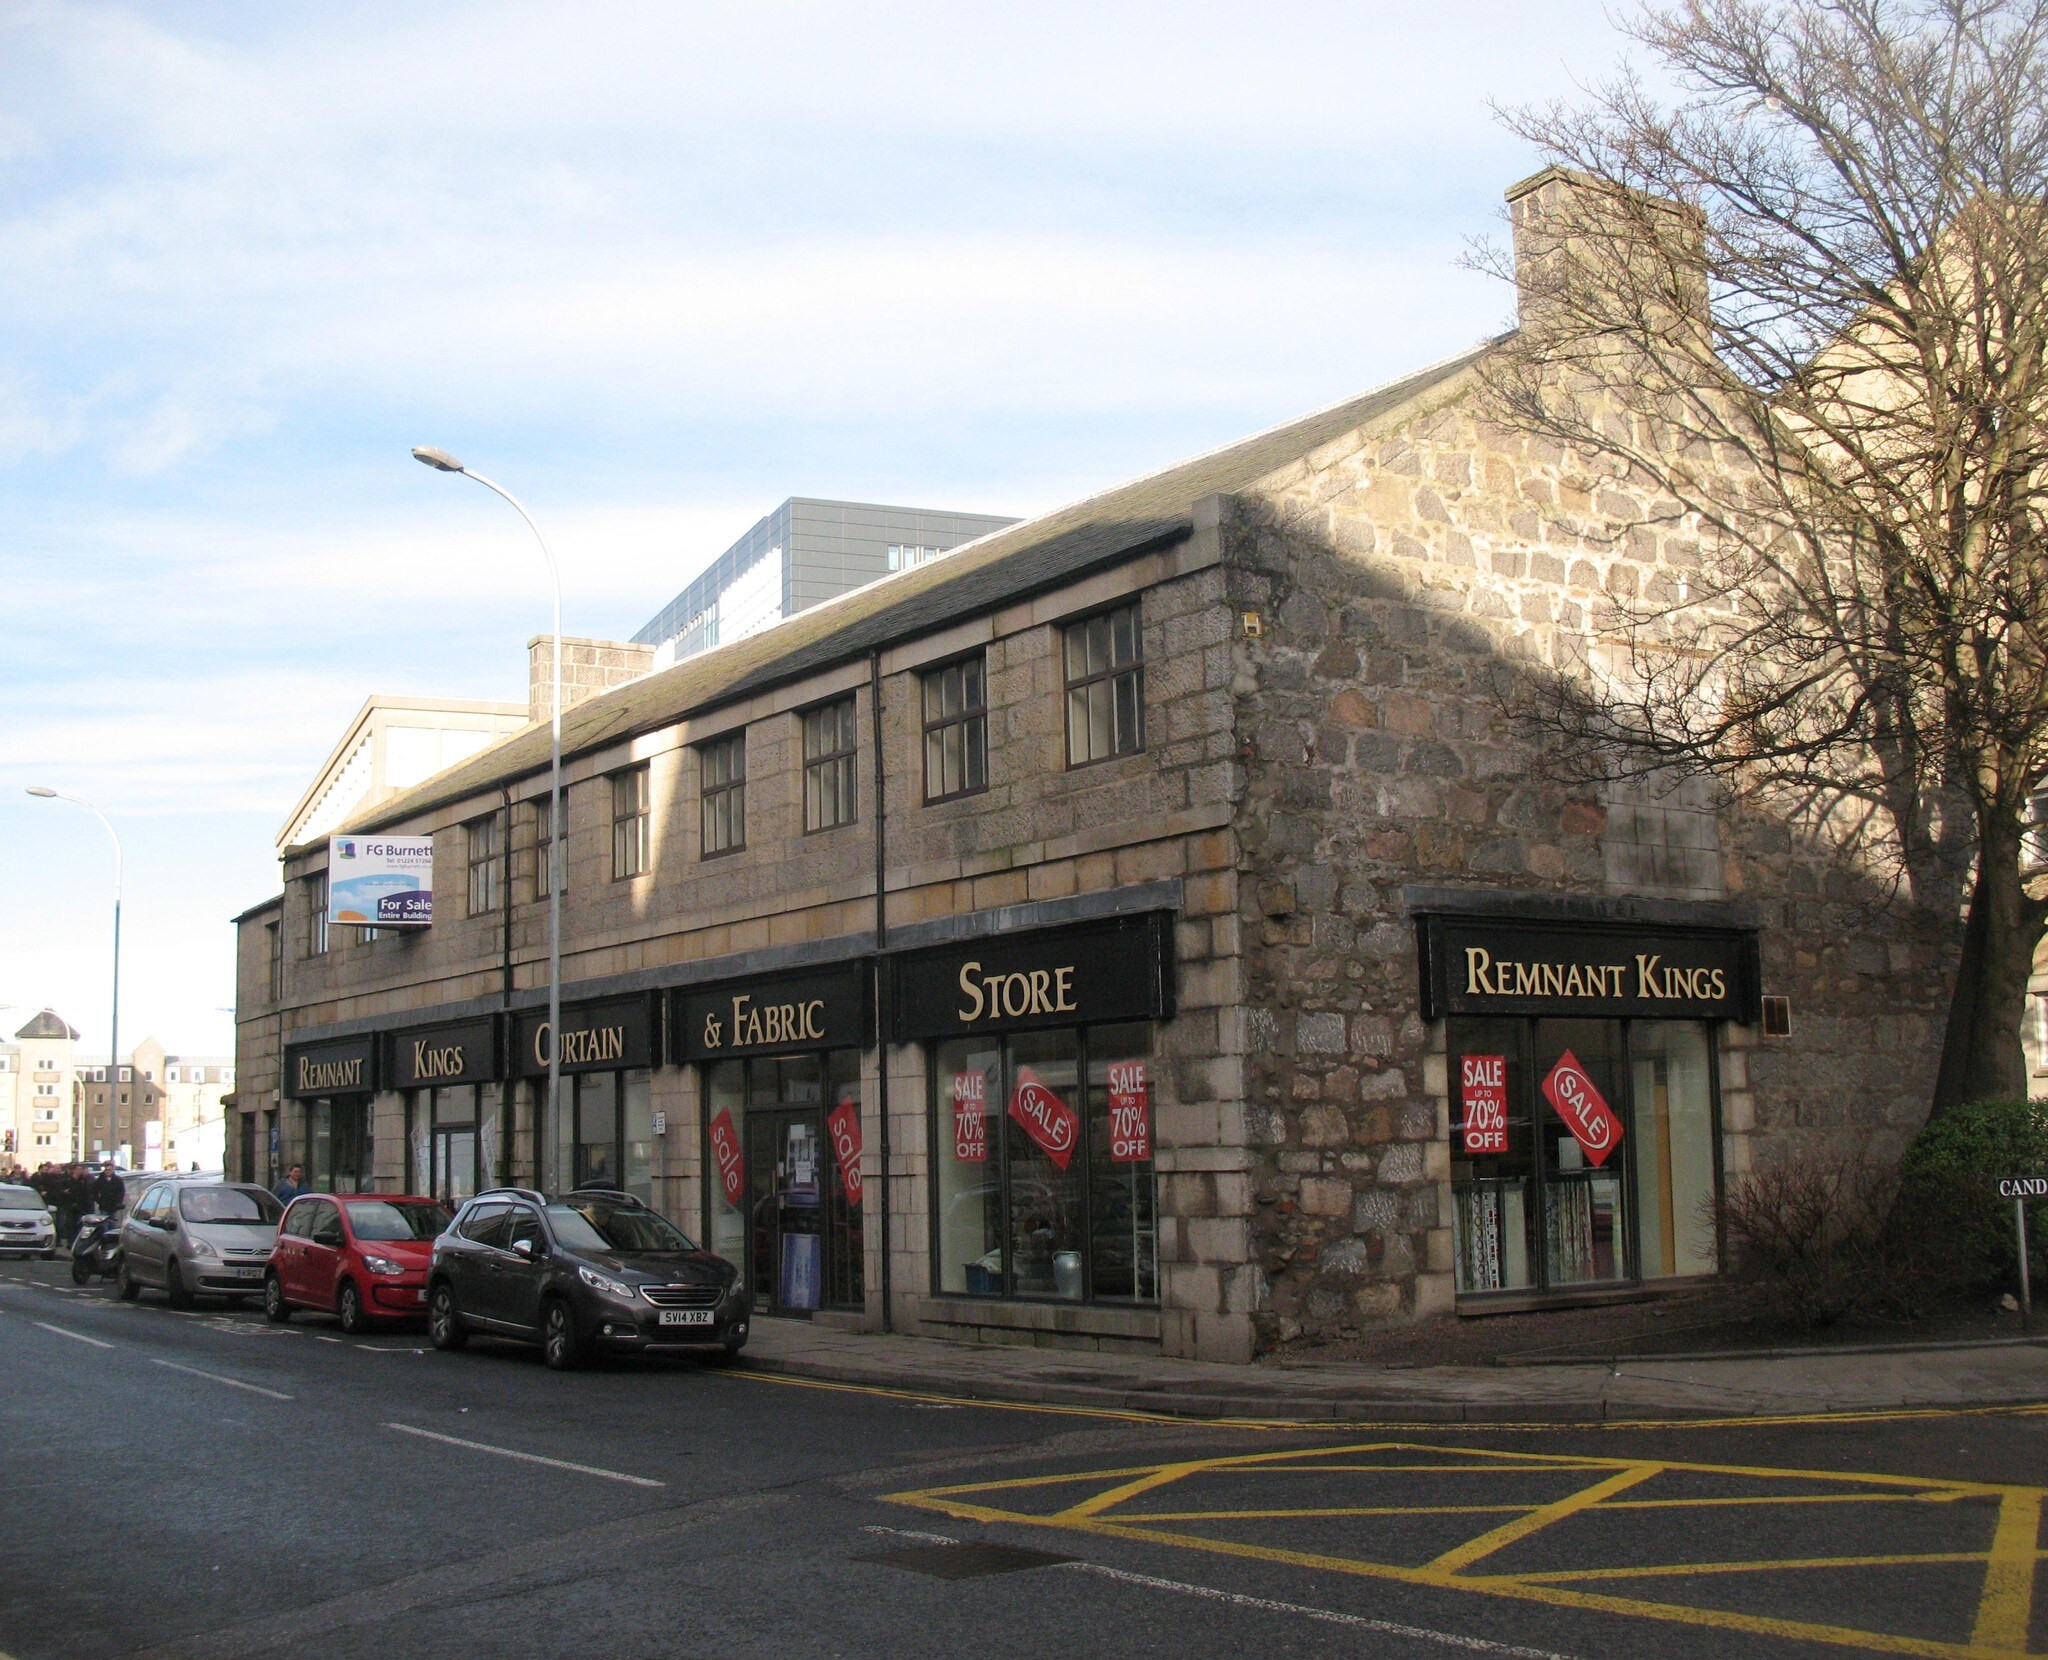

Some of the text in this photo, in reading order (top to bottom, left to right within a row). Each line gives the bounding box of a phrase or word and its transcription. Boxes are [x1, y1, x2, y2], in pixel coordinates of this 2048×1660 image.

[366, 844, 432, 857] FG Burnett
[378, 911, 432, 921] Entire Building
[381, 899, 432, 911] For Sale
[1464, 946, 1726, 1000] REMNANT KINGS
[958, 961, 1078, 1022] STORE
[704, 994, 825, 1049] & FABRIC
[299, 1055, 363, 1091] REMNANT
[413, 1039, 464, 1079] KINGS
[954, 1075, 983, 1101] SALE
[1110, 1065, 1144, 1096] SALE
[1463, 1060, 1503, 1088] SALE
[1120, 1096, 1136, 1106] UP TO
[1474, 1089, 1492, 1098] UP TO
[1560, 1074, 1606, 1142] SALE
[956, 1111, 984, 1140] 70%
[1023, 1088, 1067, 1144] SALE
[1111, 1105, 1146, 1138] 70%
[1465, 1099, 1504, 1130] 70%
[834, 1117, 862, 1191] sale
[956, 1142, 985, 1158] OFF
[1113, 1139, 1146, 1157] OFF
[1466, 1132, 1504, 1149] OFF
[713, 1126, 740, 1193] sale
[1999, 1178, 2048, 1197] CAND
[665, 1312, 708, 1323] SV14 XBZ
